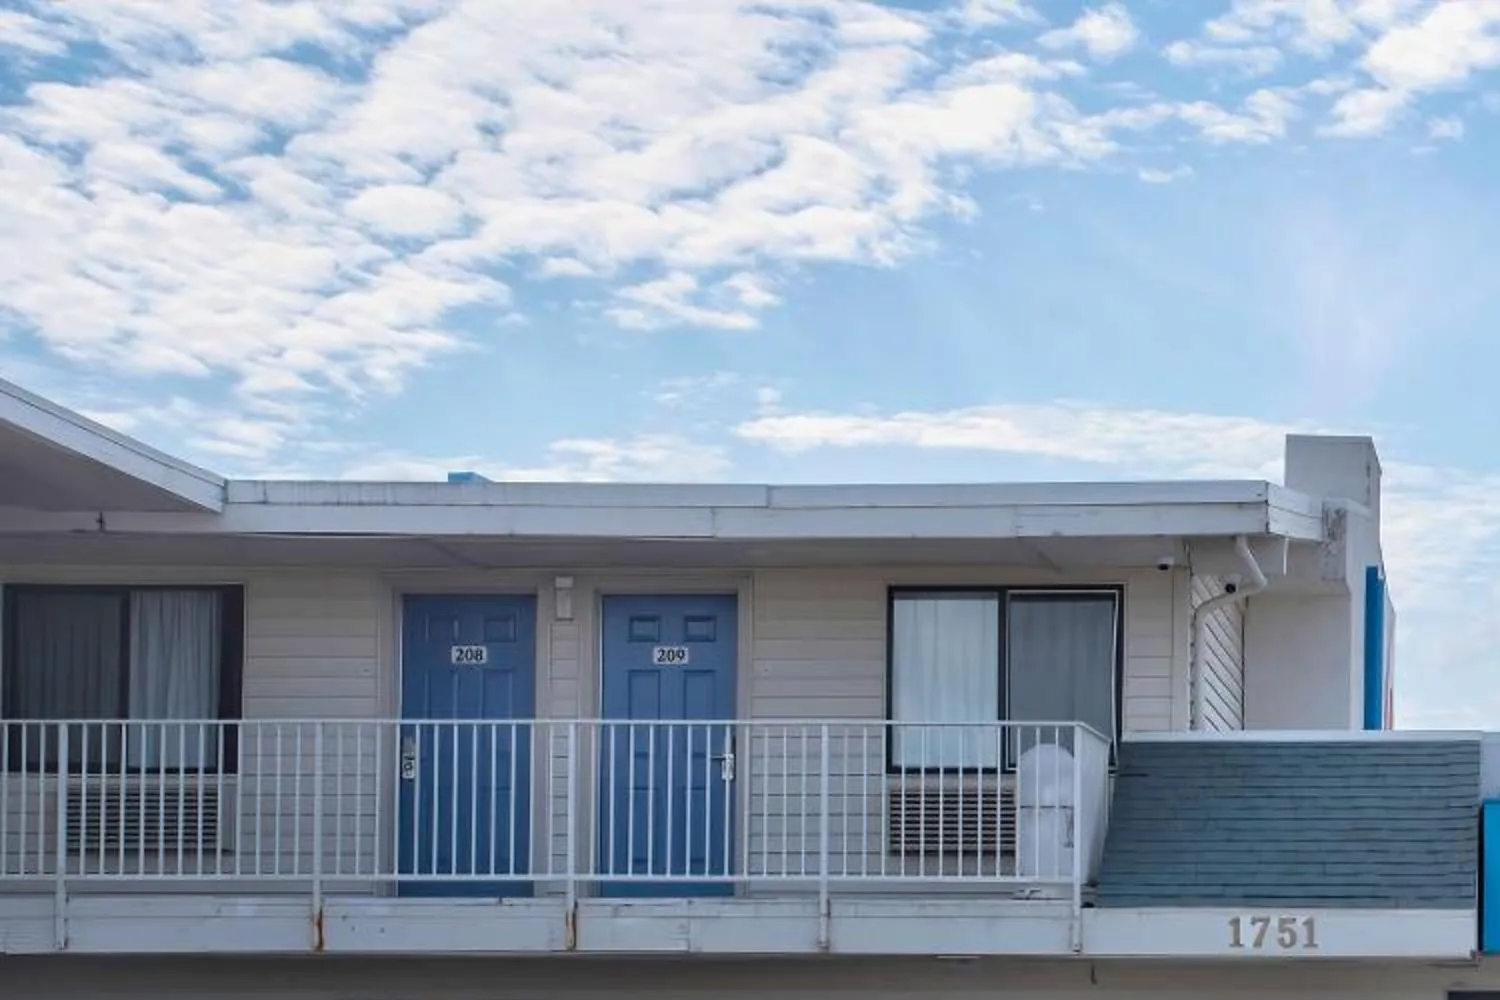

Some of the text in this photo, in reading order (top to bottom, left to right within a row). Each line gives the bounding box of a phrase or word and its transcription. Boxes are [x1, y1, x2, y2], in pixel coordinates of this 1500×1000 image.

[455, 647, 483, 661] 208
[657, 647, 685, 661] 209
[1228, 915, 1319, 949] 1751
